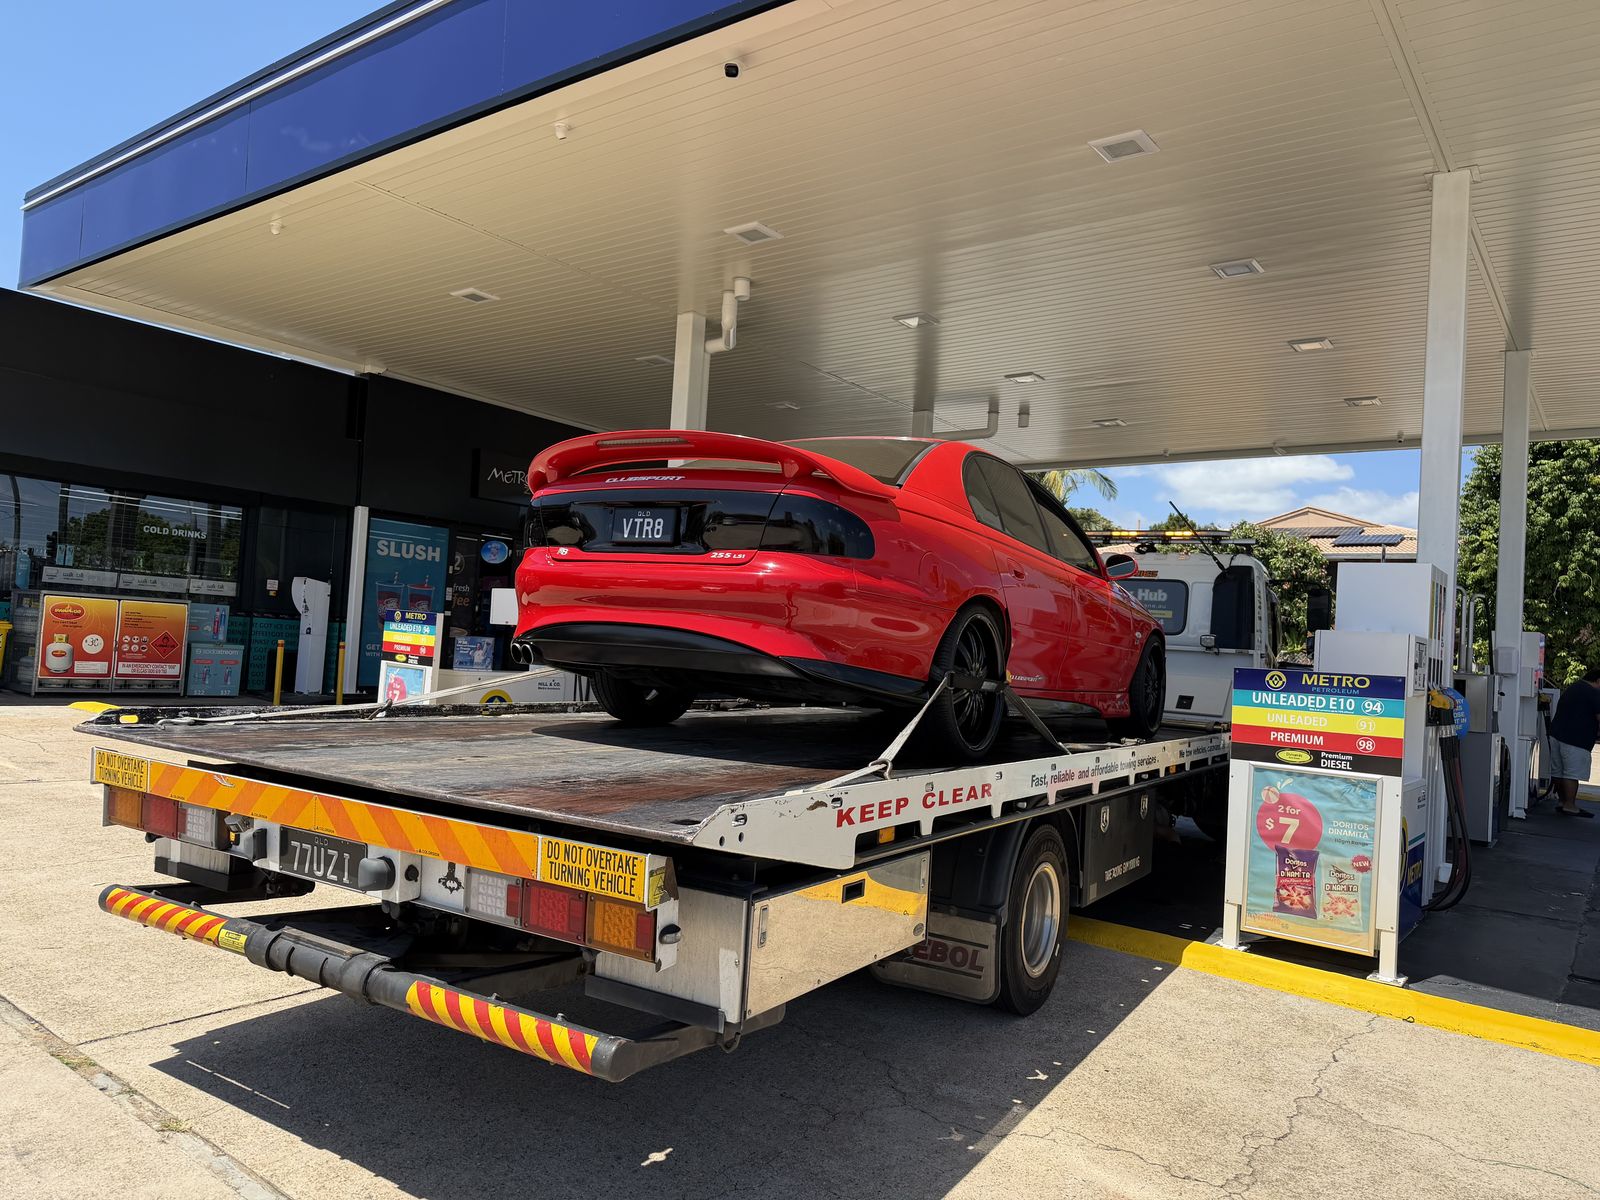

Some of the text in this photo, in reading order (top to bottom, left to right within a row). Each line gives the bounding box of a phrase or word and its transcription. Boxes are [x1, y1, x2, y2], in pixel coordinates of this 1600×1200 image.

[143, 525, 207, 540] COLD DRINKS
[623, 518, 664, 538] VTR8
[376, 539, 441, 562] SLUSH
[710, 551, 732, 559] 255
[1137, 588, 1168, 602] Hub
[405, 612, 427, 621] METRO
[389, 622, 413, 632] UNLEADED
[1301, 673, 1371, 689] METRO
[1311, 686, 1360, 695] PETROLEUM
[1252, 691, 1326, 709] UNLEADED
[1329, 697, 1355, 711] E10
[1364, 701, 1382, 713] 94
[1267, 713, 1373, 731] UNLEADED 91
[1270, 731, 1373, 750] PREMIUM 98
[98, 751, 145, 774] DO NOT OVERTAKE
[1320, 751, 1353, 761] Premium
[1320, 759, 1352, 770] DIESEL
[99, 766, 143, 789] TURNING VEHICLE
[1030, 774, 1049, 788] Fast,
[1050, 768, 1075, 784] reliable
[1077, 766, 1090, 780] and
[1090, 760, 1119, 776] affordable
[1119, 758, 1137, 772] towing
[836, 783, 993, 828] KEEP CLEAR
[1277, 804, 1301, 815] 2 for
[1332, 820, 1369, 831] DORITOS
[1328, 827, 1369, 839] DINAMITA
[315, 836, 329, 846] QLD
[546, 840, 638, 876] DO NOT OVERTAKE
[1285, 858, 1307, 867] Doritos
[549, 861, 590, 887] TURNING
[593, 869, 636, 897] VEHICLE
[1330, 870, 1355, 880] Doritos
